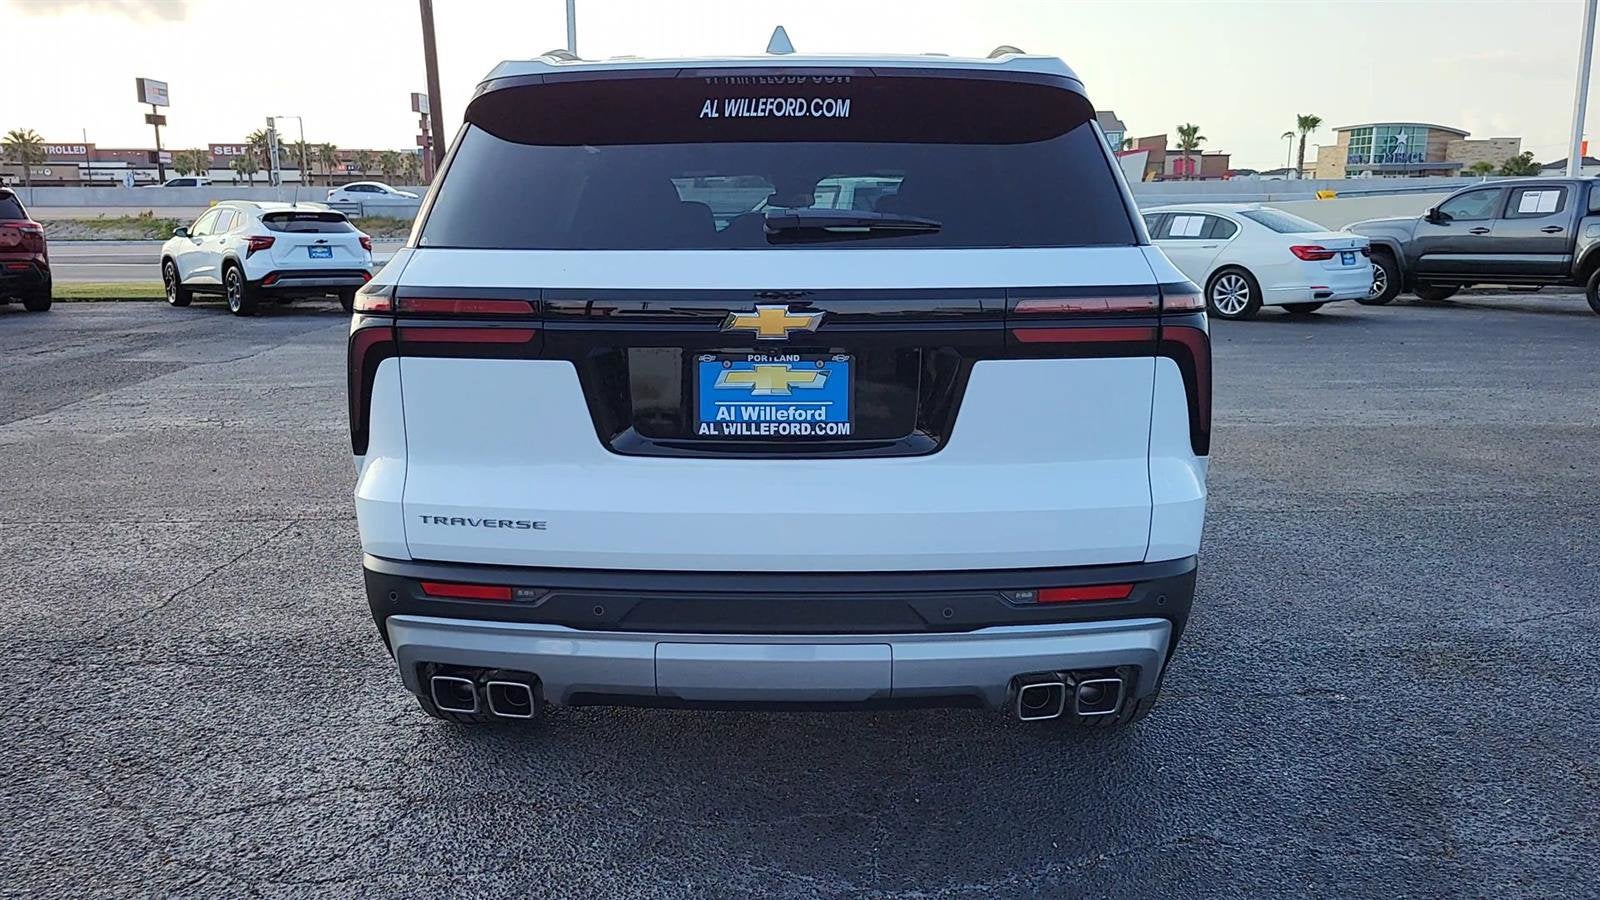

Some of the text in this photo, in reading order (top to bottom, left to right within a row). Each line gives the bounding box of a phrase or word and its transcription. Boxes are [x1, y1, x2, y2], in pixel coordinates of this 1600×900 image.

[700, 98, 851, 118] AL WILLEFORD.COM
[40, 145, 87, 155] TROLLED
[716, 406, 826, 421] Al Willeford
[699, 422, 850, 435] AL WILLEFORD.COM
[419, 515, 547, 530] TRAVERSE
